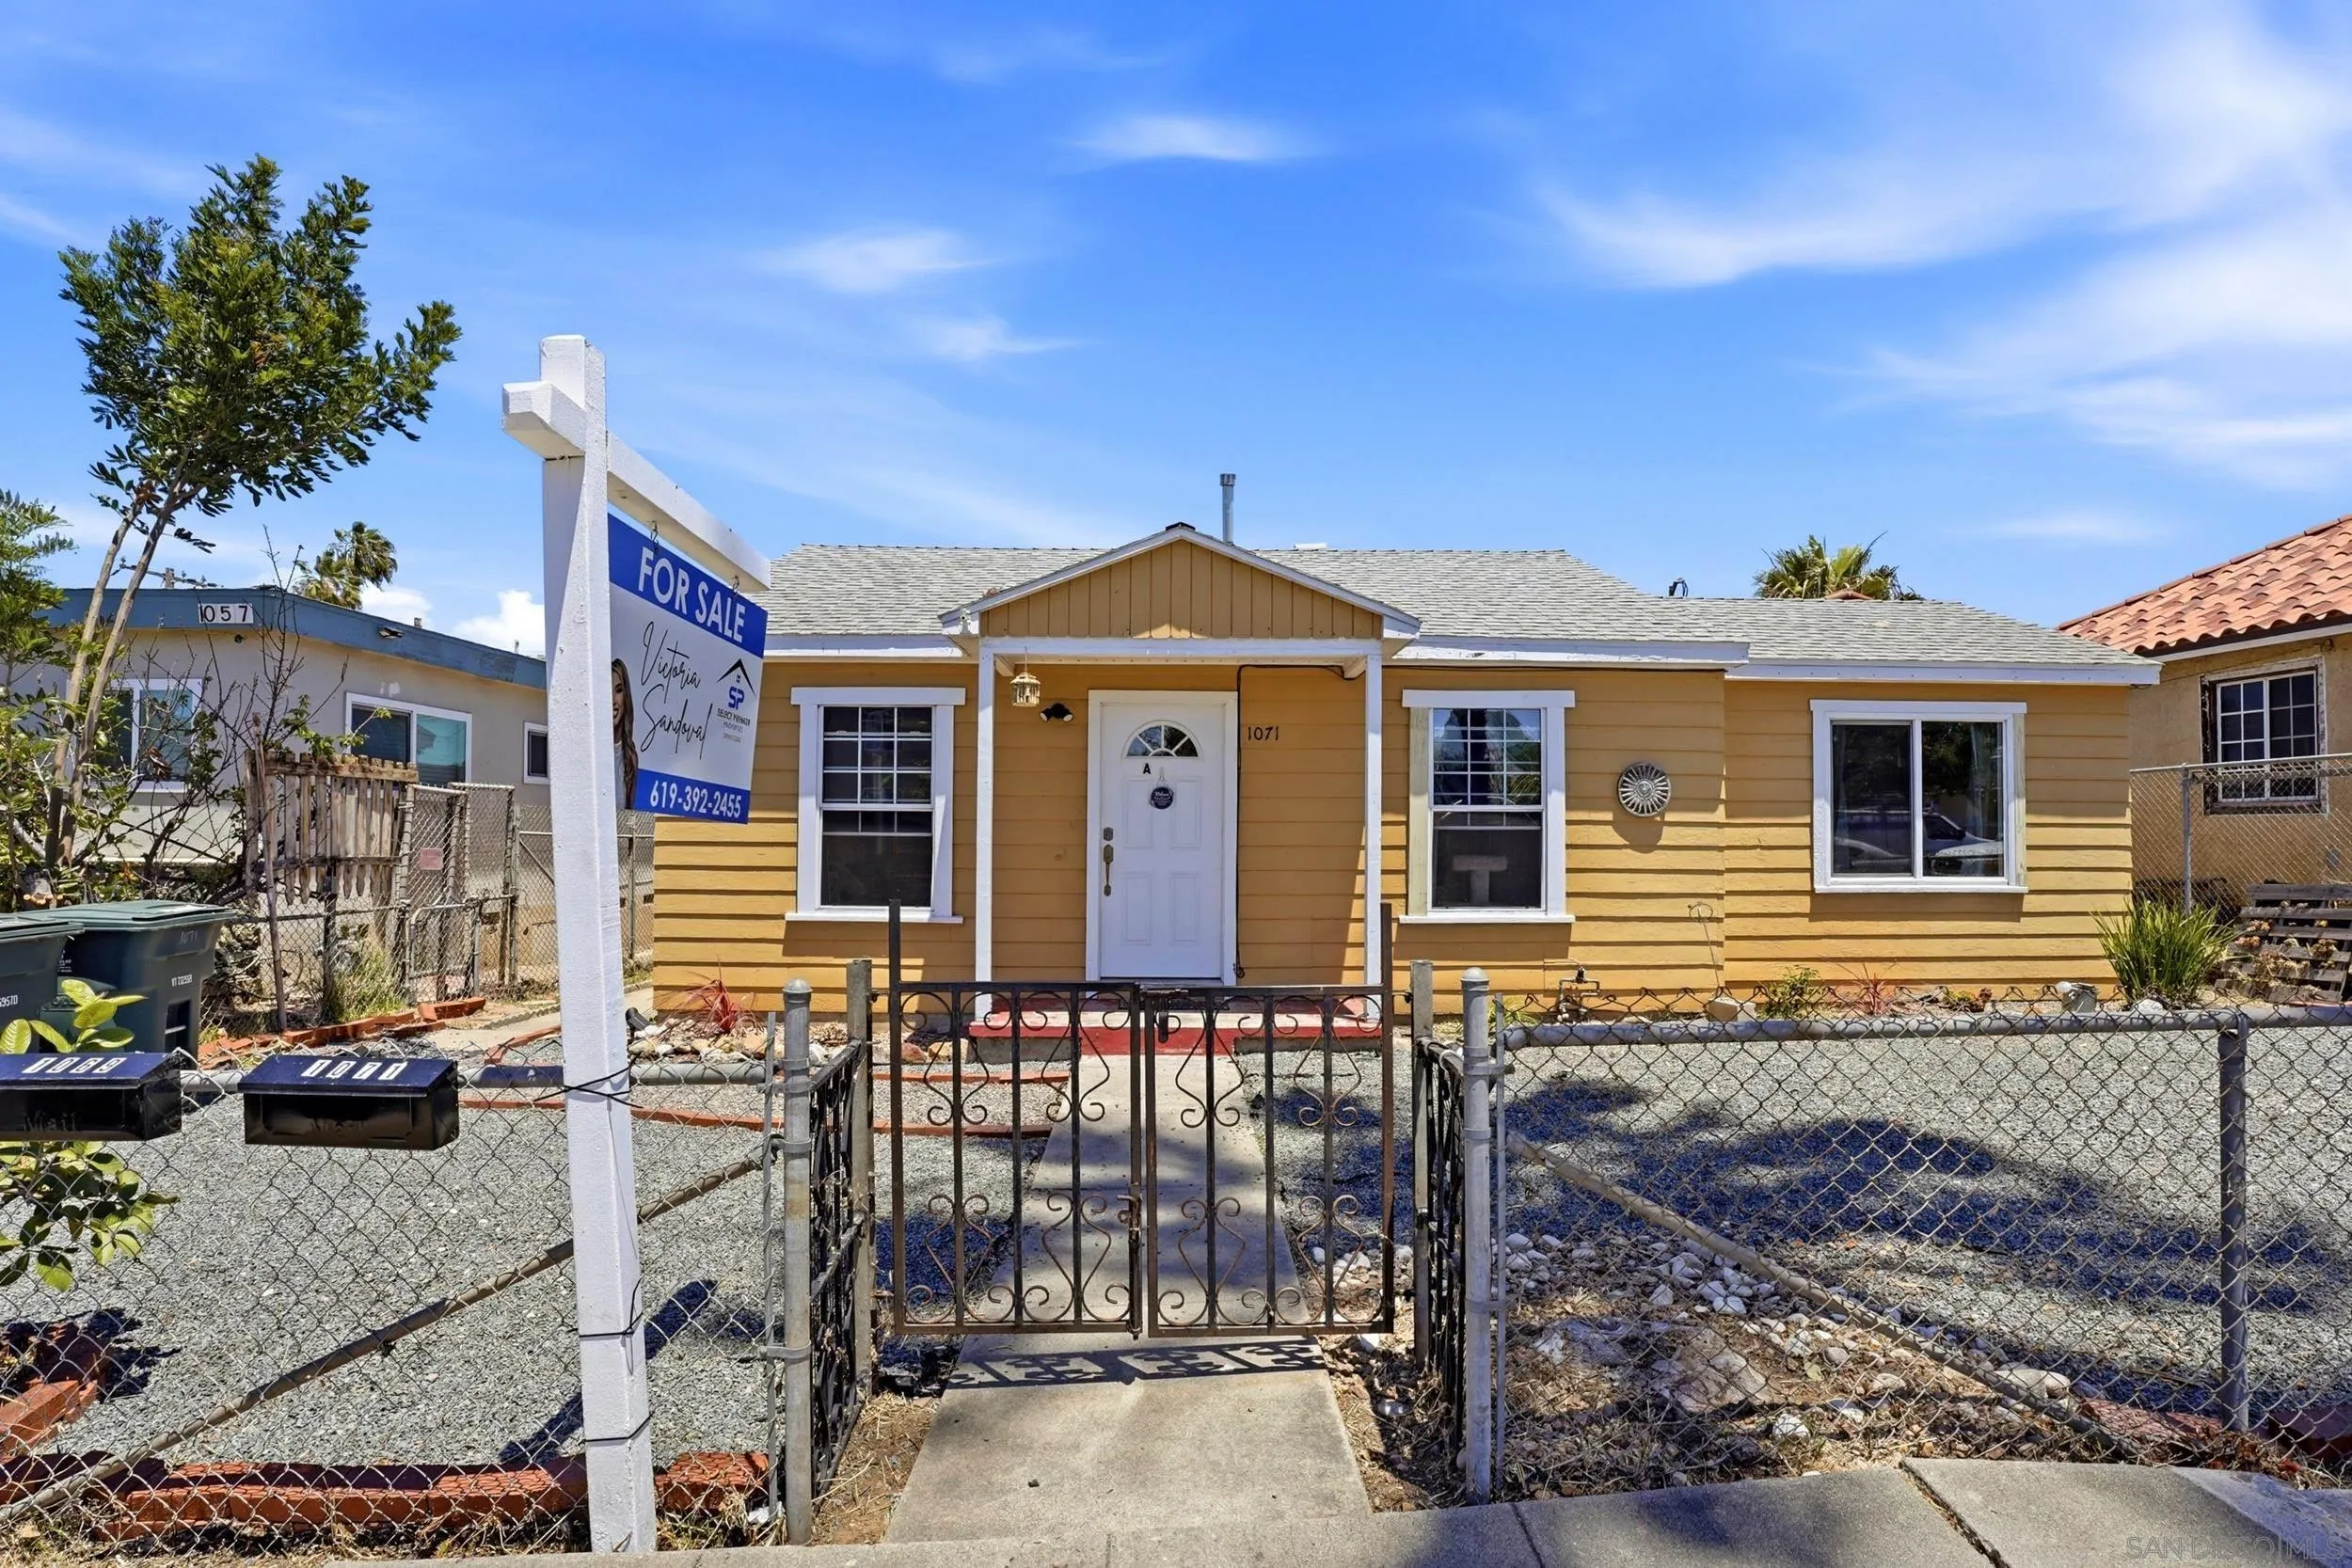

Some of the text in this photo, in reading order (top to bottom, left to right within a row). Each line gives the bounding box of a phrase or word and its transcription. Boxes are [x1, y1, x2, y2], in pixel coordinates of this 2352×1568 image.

[639, 546, 746, 643] FOR SALE
[199, 605, 247, 622] 1057
[641, 622, 701, 704] Victoria
[728, 686, 745, 710] SP
[641, 684, 713, 759] Sandoval
[1248, 726, 1279, 741] 1071
[1142, 763, 1152, 775] A
[650, 780, 741, 818] 619-392-2455
[25, 1057, 124, 1073] 1069
[304, 1060, 406, 1080] 1071
